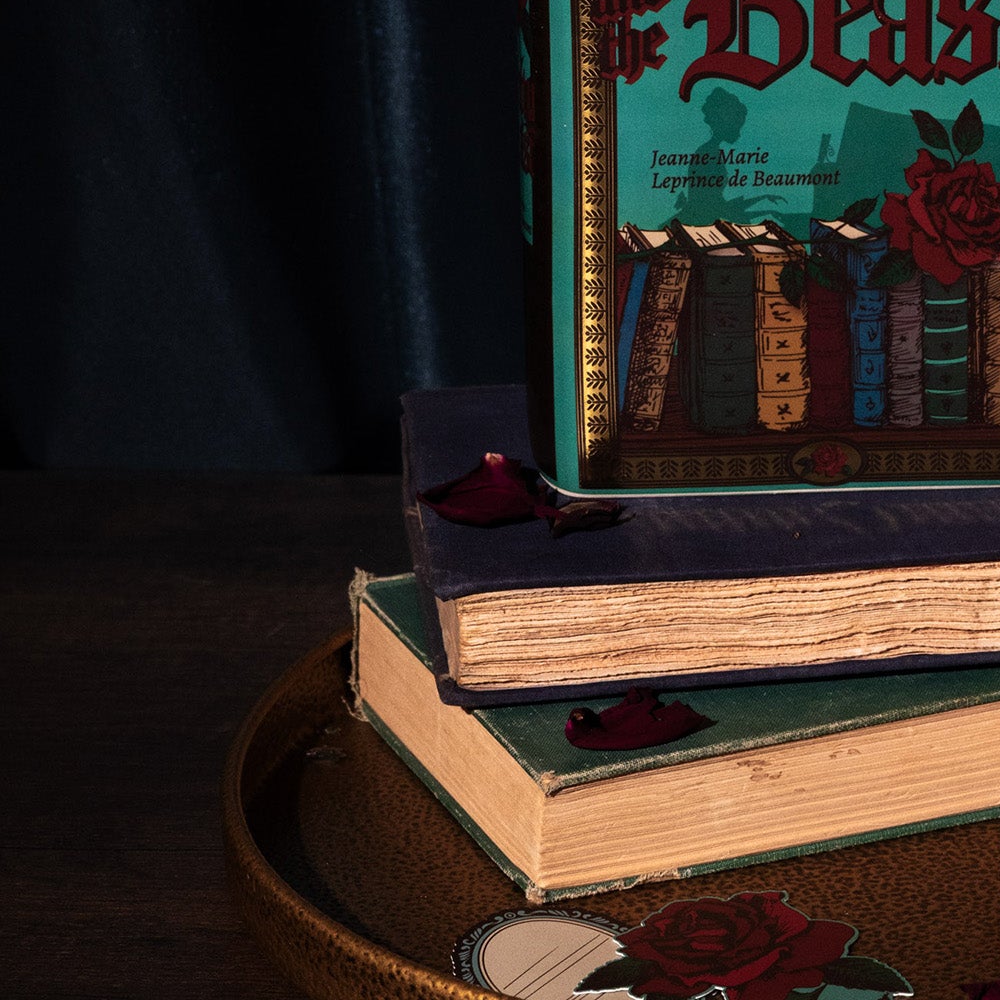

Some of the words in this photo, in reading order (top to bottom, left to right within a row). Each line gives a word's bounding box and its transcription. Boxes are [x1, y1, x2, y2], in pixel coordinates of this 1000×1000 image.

[598, 13, 670, 85] the
[650, 147, 770, 169] Jeanne-Marie
[651, 171, 724, 193] Leprince
[727, 170, 748, 188] de
[752, 170, 841, 187] Beaumont
